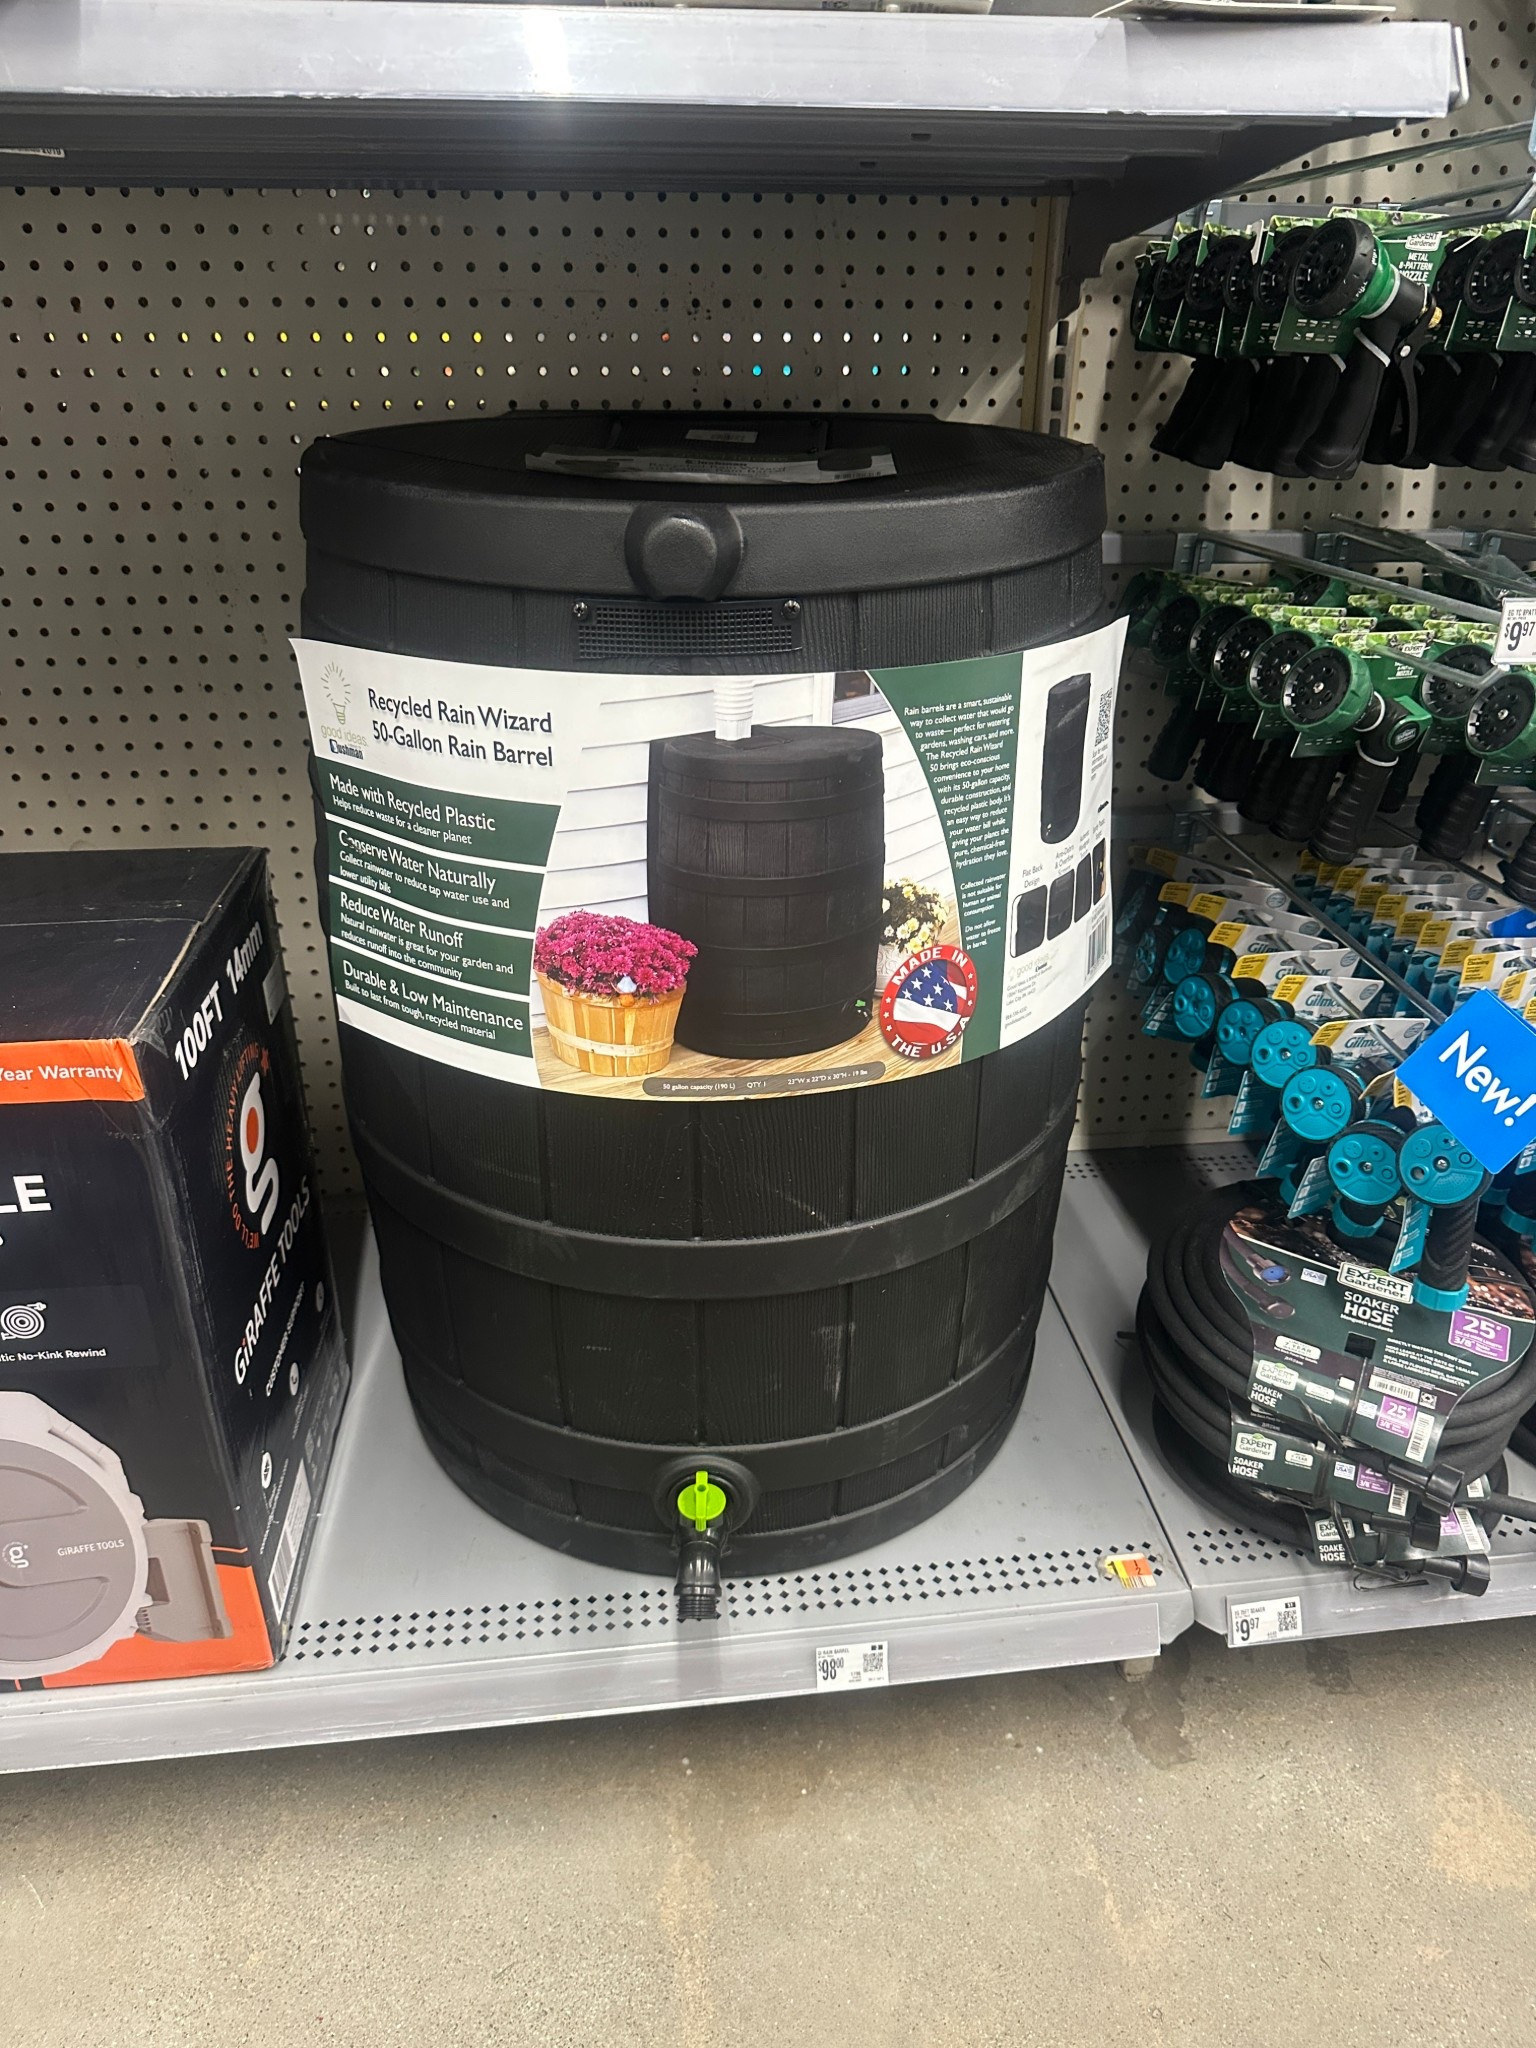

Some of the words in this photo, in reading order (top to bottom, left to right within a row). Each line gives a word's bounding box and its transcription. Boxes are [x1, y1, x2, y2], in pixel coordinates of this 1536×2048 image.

[1409, 239, 1436, 247] Gardener
[1407, 252, 1428, 261] METAL
[368, 688, 432, 719] Recycled
[438, 700, 475, 725] Rain
[477, 705, 552, 733] Wizard
[904, 707, 919, 716] Rain
[921, 703, 944, 714] barrels
[946, 703, 957, 711] are
[964, 699, 982, 709] smart,
[983, 692, 1012, 706] sustainable
[910, 720, 923, 728] way
[925, 718, 933, 726] to
[935, 715, 956, 724] collect
[958, 712, 976, 721] water
[977, 708, 989, 718] that
[990, 706, 1007, 716] would
[1007, 705, 1014, 714] go
[915, 731, 923, 739] to
[954, 723, 975, 736] perfect
[976, 720, 985, 728] for
[987, 717, 1010, 727] watering
[321, 725, 342, 739] good
[372, 720, 442, 753] 50-Gallon
[448, 735, 486, 759] Rain
[493, 741, 552, 767] Barrel
[920, 741, 947, 752] gardens,
[948, 736, 973, 746] washing
[973, 734, 988, 742] cars,
[988, 731, 998, 740] and
[999, 728, 1014, 736] more.
[926, 752, 939, 760] The
[941, 747, 968, 759] Recycled
[970, 745, 982, 754] Rain
[983, 740, 1003, 751] Wizard
[930, 763, 939, 772] 50
[940, 761, 959, 771] brings
[960, 754, 1000, 767] eco-conscious
[933, 771, 971, 783] convenience
[981, 766, 994, 777] your
[994, 762, 1010, 772] home
[329, 773, 359, 797] Made
[361, 787, 385, 805] with
[387, 791, 440, 821] Recycled
[445, 806, 496, 831] Plastic
[332, 795, 351, 811] Helps
[352, 804, 374, 817] reduce
[375, 811, 394, 824] waste
[396, 816, 406, 827] for
[407, 822, 411, 830] a
[413, 822, 440, 838] cleaner
[443, 830, 472, 844] planet
[339, 829, 388, 861] Conserve
[388, 846, 424, 874] Water
[427, 860, 496, 895] Naturally
[340, 850, 363, 868] Collect
[364, 861, 393, 878] rainwater
[395, 872, 402, 882] to
[404, 877, 427, 892] reduce
[428, 885, 441, 898] tap
[443, 889, 469, 902] water
[472, 895, 489, 905] use
[491, 898, 509, 909] and
[340, 865, 358, 880] lower
[360, 875, 378, 890] utility
[379, 880, 391, 894] bills
[340, 891, 380, 920] Reduce
[381, 906, 415, 934] Water
[419, 921, 463, 948] Runoff
[341, 912, 365, 930] Natural
[366, 925, 397, 943] rainwater
[398, 935, 404, 946] is
[405, 940, 424, 953] great
[426, 944, 438, 956] for
[440, 951, 459, 962] your
[462, 957, 493, 970] garden
[496, 964, 514, 974] and
[341, 930, 366, 945] reduces
[367, 941, 387, 954] runoff
[388, 946, 402, 959] into
[404, 953, 416, 965] the
[418, 960, 462, 980] community
[226, 921, 263, 995] 14mm
[891, 946, 943, 986] MADE
[951, 949, 968, 968] IN
[343, 960, 387, 990] Durable
[389, 979, 399, 996] &
[402, 982, 429, 1005] Low
[432, 992, 523, 1030] Maintenance
[345, 980, 361, 994] Built
[361, 988, 369, 997] to
[370, 990, 382, 1003] last
[383, 995, 400, 1010] from
[402, 1005, 424, 1020] tough,
[426, 1013, 458, 1029] recycled
[461, 1024, 496, 1039] material
[174, 980, 223, 1081] 100FT
[891, 1033, 922, 1058] THE
[38, 1065, 123, 1082] Warranty
[235, 1042, 259, 1084] LIFTING
[671, 1083, 689, 1091] gallon
[690, 1083, 713, 1091] capacity
[1438, 1029, 1536, 1127] New!
[225, 1085, 239, 1150] HEAVY
[225, 1160, 235, 1202] THE
[232, 1203, 241, 1231] DO
[234, 1252, 280, 1385] GiRAFFE
[278, 1175, 310, 1264] TOOLS
[1344, 1275, 1406, 1298] Gardener
[1346, 1267, 1408, 1291] EXPERT
[1343, 1290, 1400, 1315] SOAKER
[1343, 1301, 1395, 1327] HOSE
[18, 1350, 63, 1361] No-Kink
[65, 1348, 107, 1358] Rewind
[1260, 1370, 1292, 1386] Gardener
[1261, 1364, 1295, 1380] EXPERT
[1250, 1390, 1278, 1408] HOSE
[1239, 1444, 1271, 1456] Gardener
[1240, 1437, 1273, 1450] EXPERT
[1231, 1464, 1259, 1479] HOSE
[1233, 1456, 1264, 1471] SOAKER
[57, 1543, 96, 1556] GiRAFFE
[96, 1539, 125, 1551] TOOLS
[1320, 1552, 1346, 1562] HOSE
